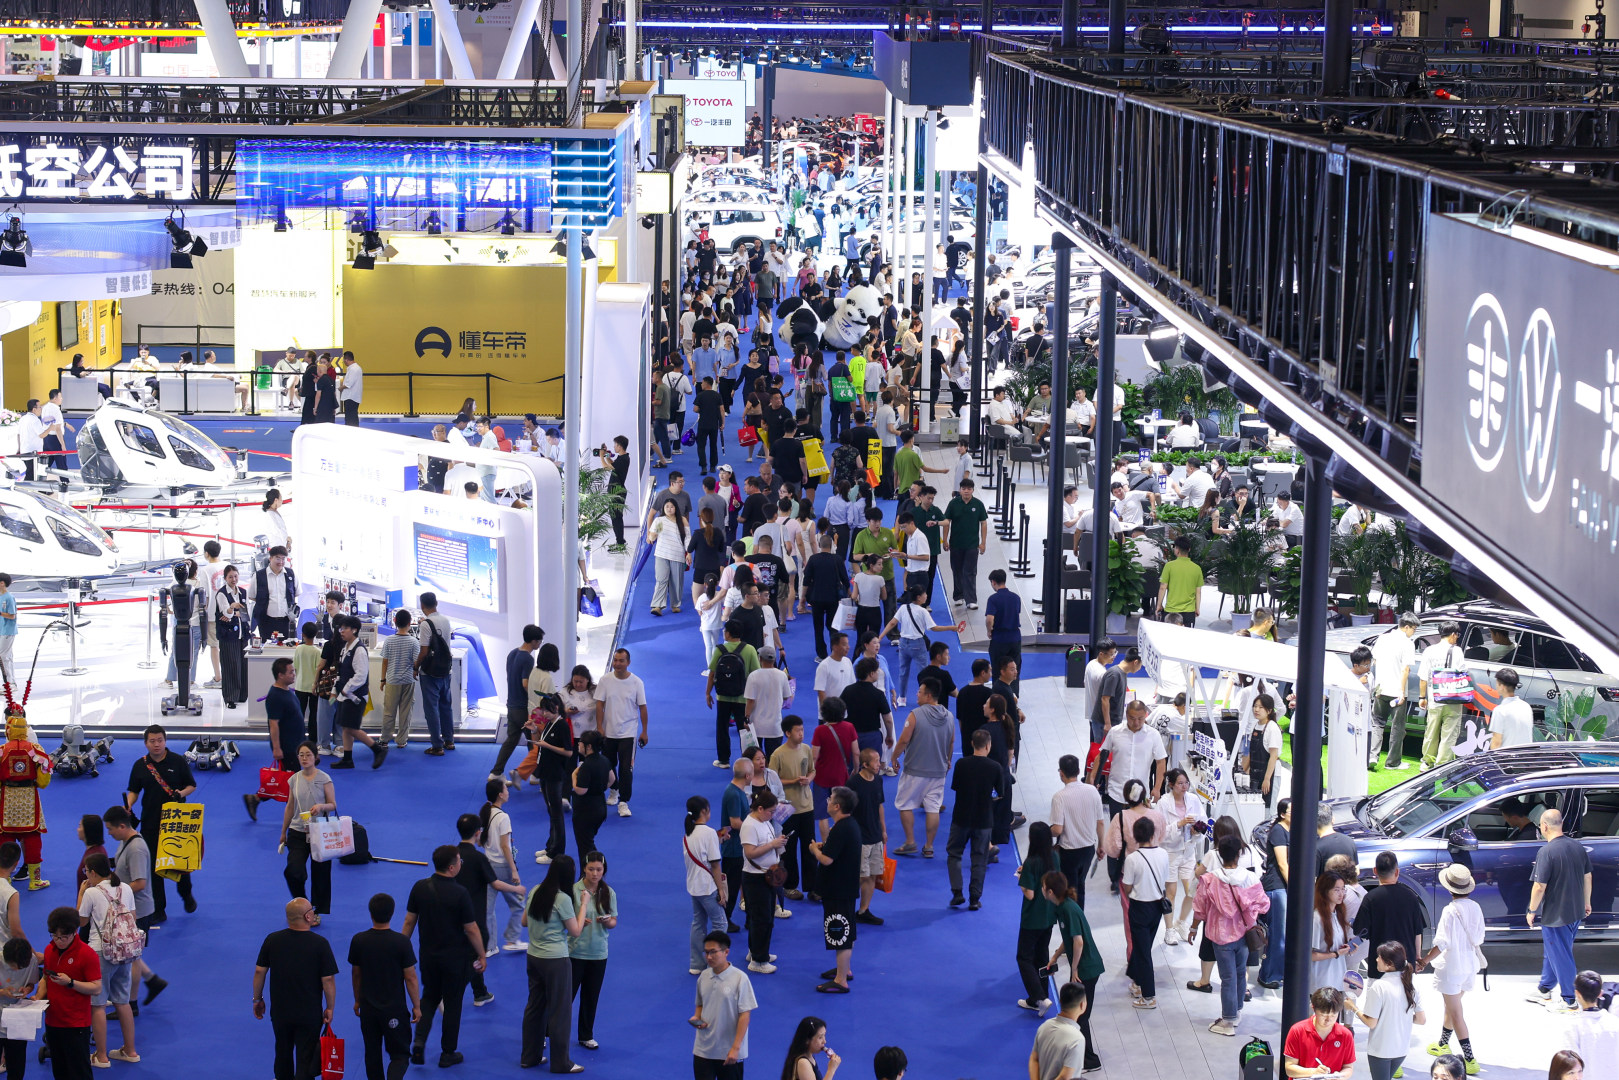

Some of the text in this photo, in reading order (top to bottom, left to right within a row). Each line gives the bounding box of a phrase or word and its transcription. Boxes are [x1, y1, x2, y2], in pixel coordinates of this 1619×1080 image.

[692, 98, 733, 107] TOYOTA
[704, 118, 732, 126] 一汽丰田
[459, 331, 527, 351] 懂车帝
